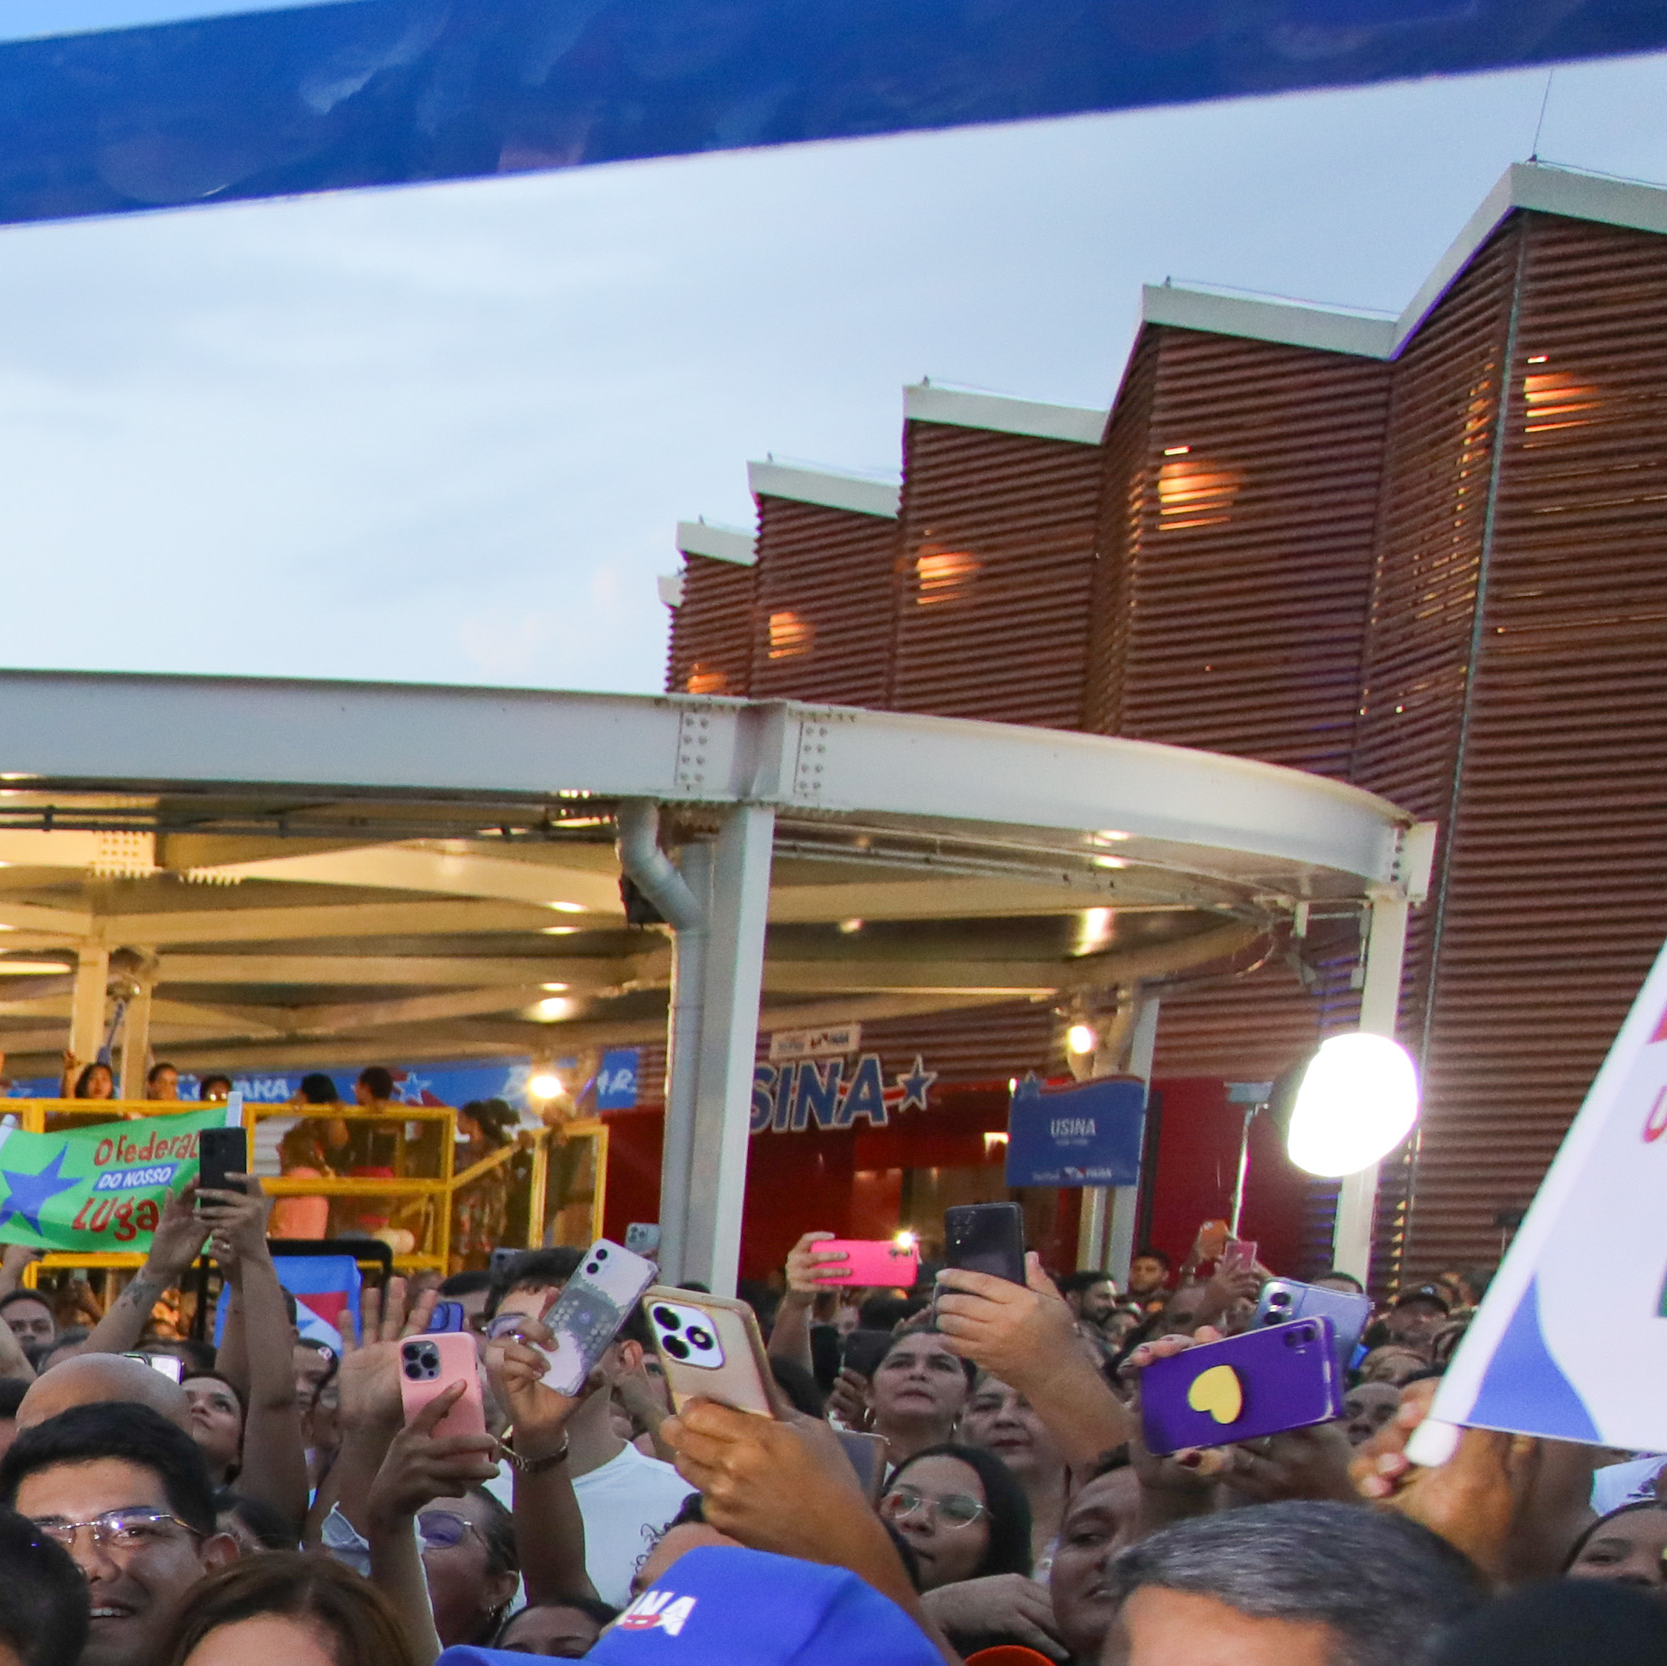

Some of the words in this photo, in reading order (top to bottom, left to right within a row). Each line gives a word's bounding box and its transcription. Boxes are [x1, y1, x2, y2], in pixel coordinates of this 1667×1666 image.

[1050, 1118, 1096, 1138] USINA
[94, 1138, 114, 1166] O
[98, 1172, 118, 1189] DO
[122, 1166, 172, 1188] NOSSO
